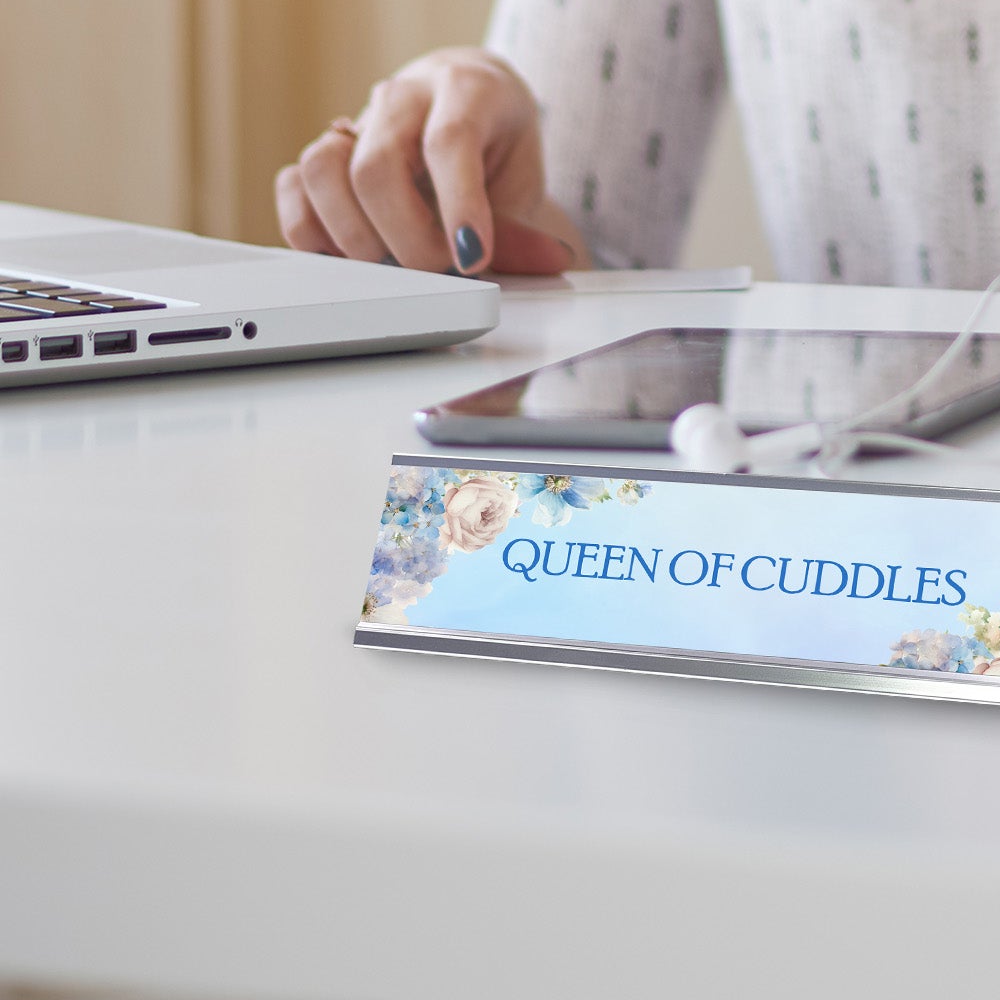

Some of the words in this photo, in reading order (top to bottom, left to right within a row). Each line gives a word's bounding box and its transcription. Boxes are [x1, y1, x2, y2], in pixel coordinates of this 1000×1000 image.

[502, 538, 663, 584] QUEEN
[668, 550, 735, 588] OF
[740, 555, 968, 607] CUDDLES
